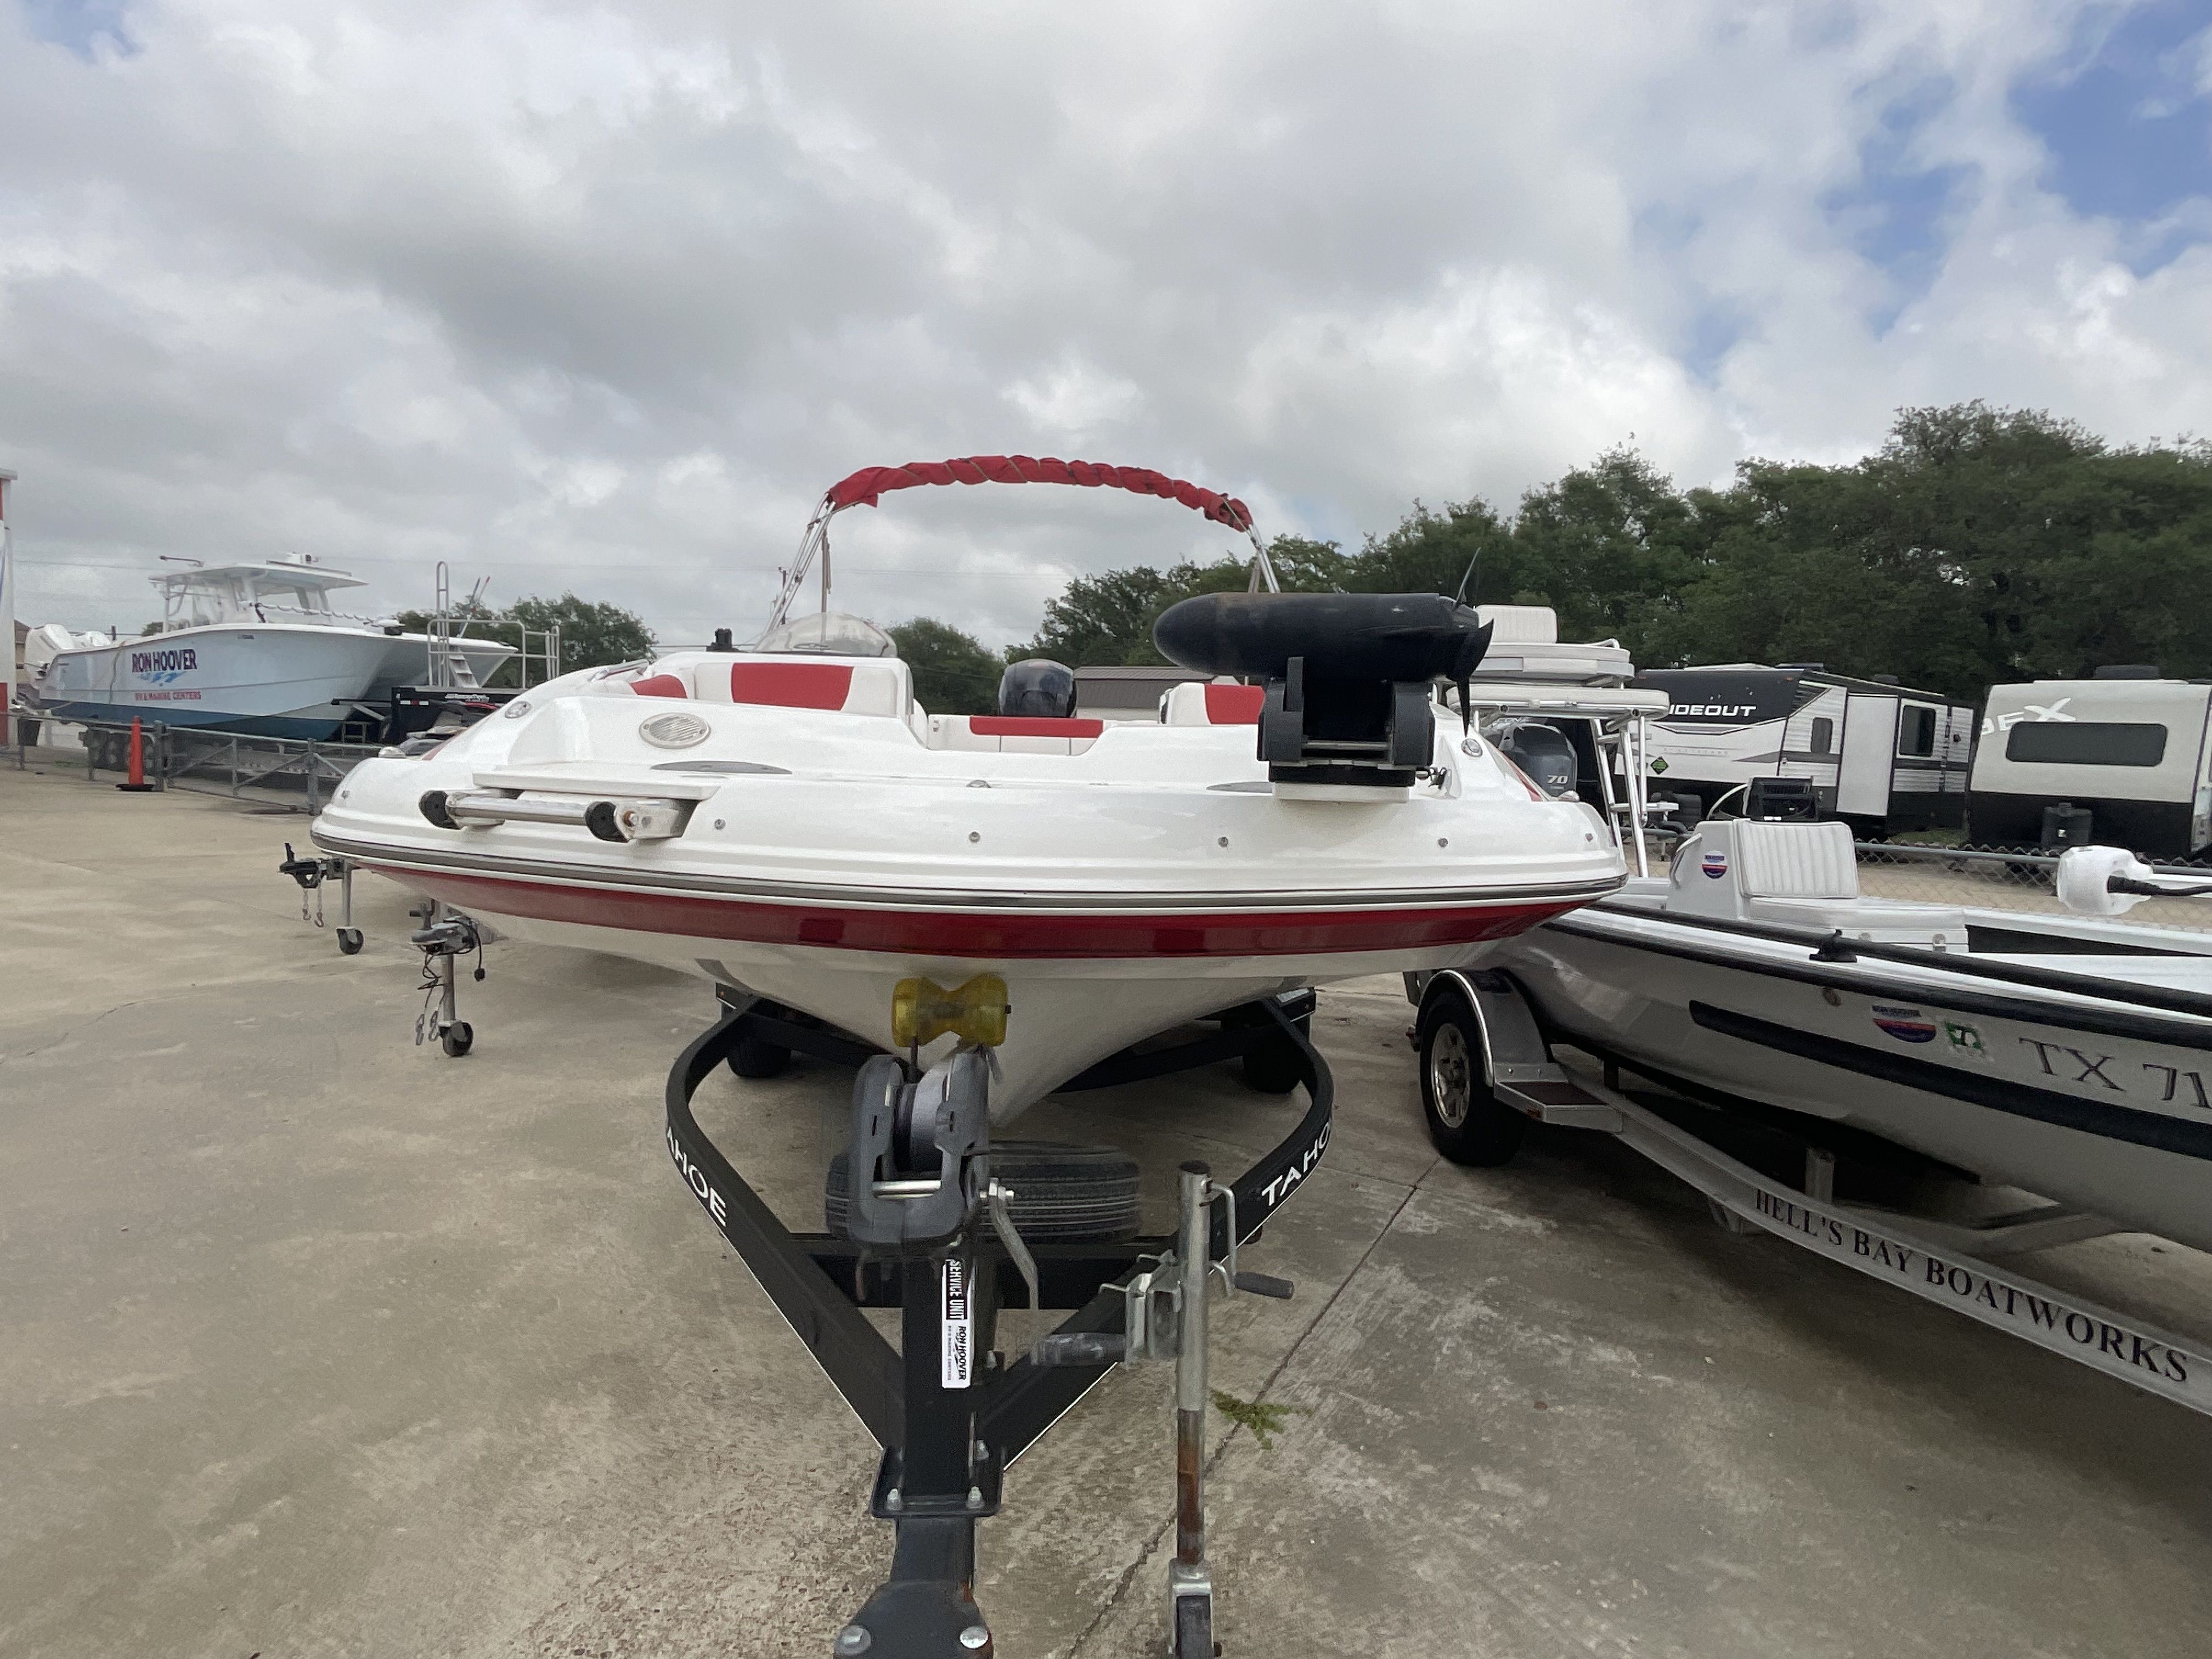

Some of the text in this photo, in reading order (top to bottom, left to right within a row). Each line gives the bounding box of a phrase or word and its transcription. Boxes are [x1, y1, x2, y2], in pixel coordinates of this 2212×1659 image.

[132, 649, 198, 673] RON HOOVER
[1669, 704, 1757, 716] IDEOUT
[1547, 775, 1568, 784] 70
[2018, 1037, 2127, 1092] TX
[1262, 1121, 1331, 1206] TAHO
[1756, 1188, 2188, 1382] HELL'S BAY BOATWORKS
[949, 1299, 964, 1321] UNIT
[958, 1325, 967, 1380] RON HOOVER
